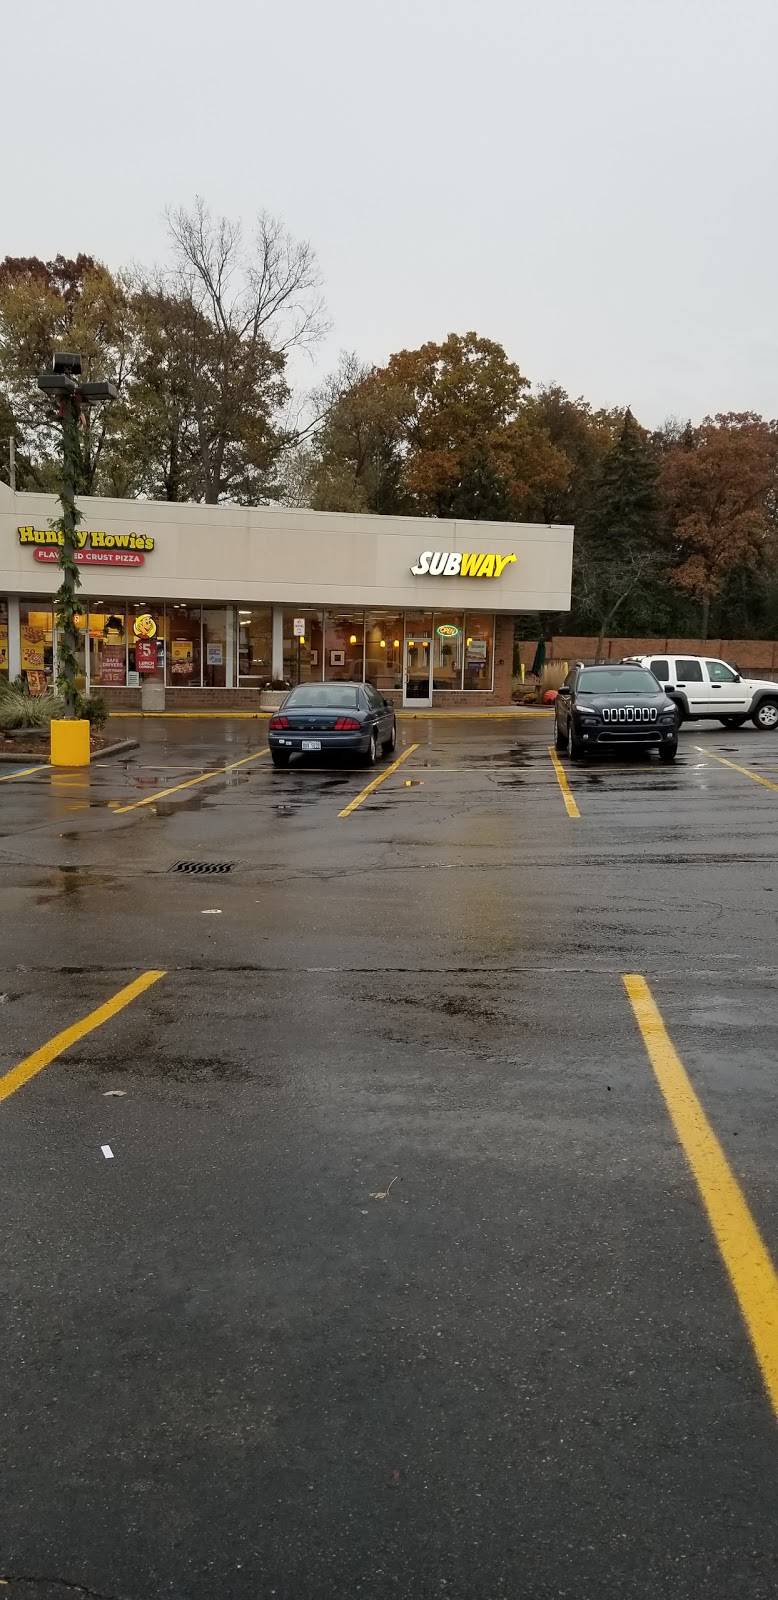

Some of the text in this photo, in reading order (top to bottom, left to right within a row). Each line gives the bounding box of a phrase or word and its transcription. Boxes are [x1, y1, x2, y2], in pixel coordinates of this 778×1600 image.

[18, 526, 154, 550] Hungy Howie's
[38, 551, 83, 560] FLAVED
[86, 553, 113, 561] CRUST
[410, 551, 518, 577] SUBWAY
[138, 642, 152, 656] $5
